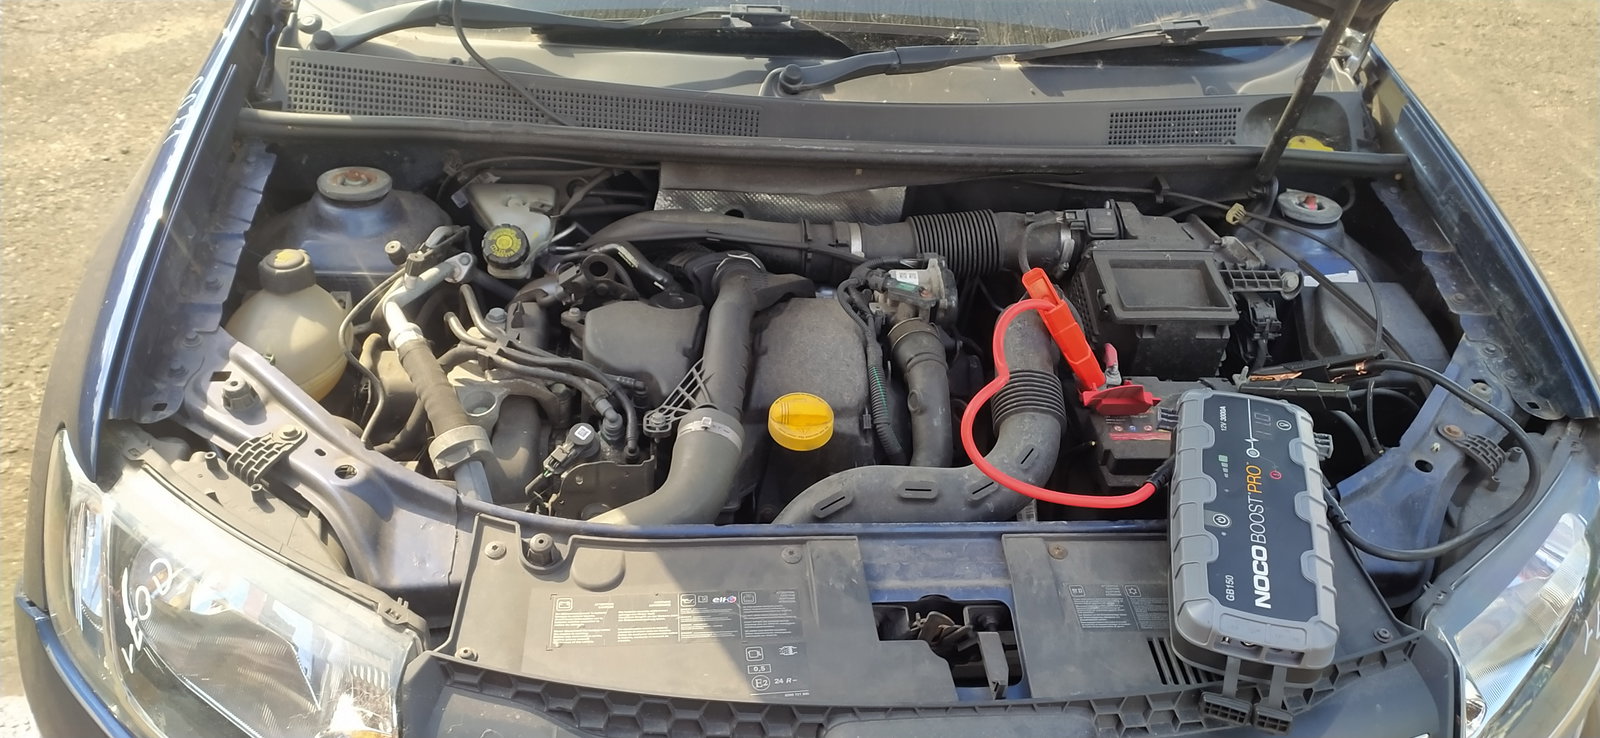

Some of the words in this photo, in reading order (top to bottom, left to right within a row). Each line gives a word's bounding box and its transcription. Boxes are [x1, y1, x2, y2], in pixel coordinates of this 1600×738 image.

[1219, 405, 1227, 422] 3000A
[1220, 421, 1228, 432] 12V
[1245, 465, 1263, 494] PRO
[1247, 494, 1267, 544] BOOST
[1225, 574, 1235, 602] GB150
[1251, 545, 1272, 609] NOCO
[755, 678, 769, 689] E2
